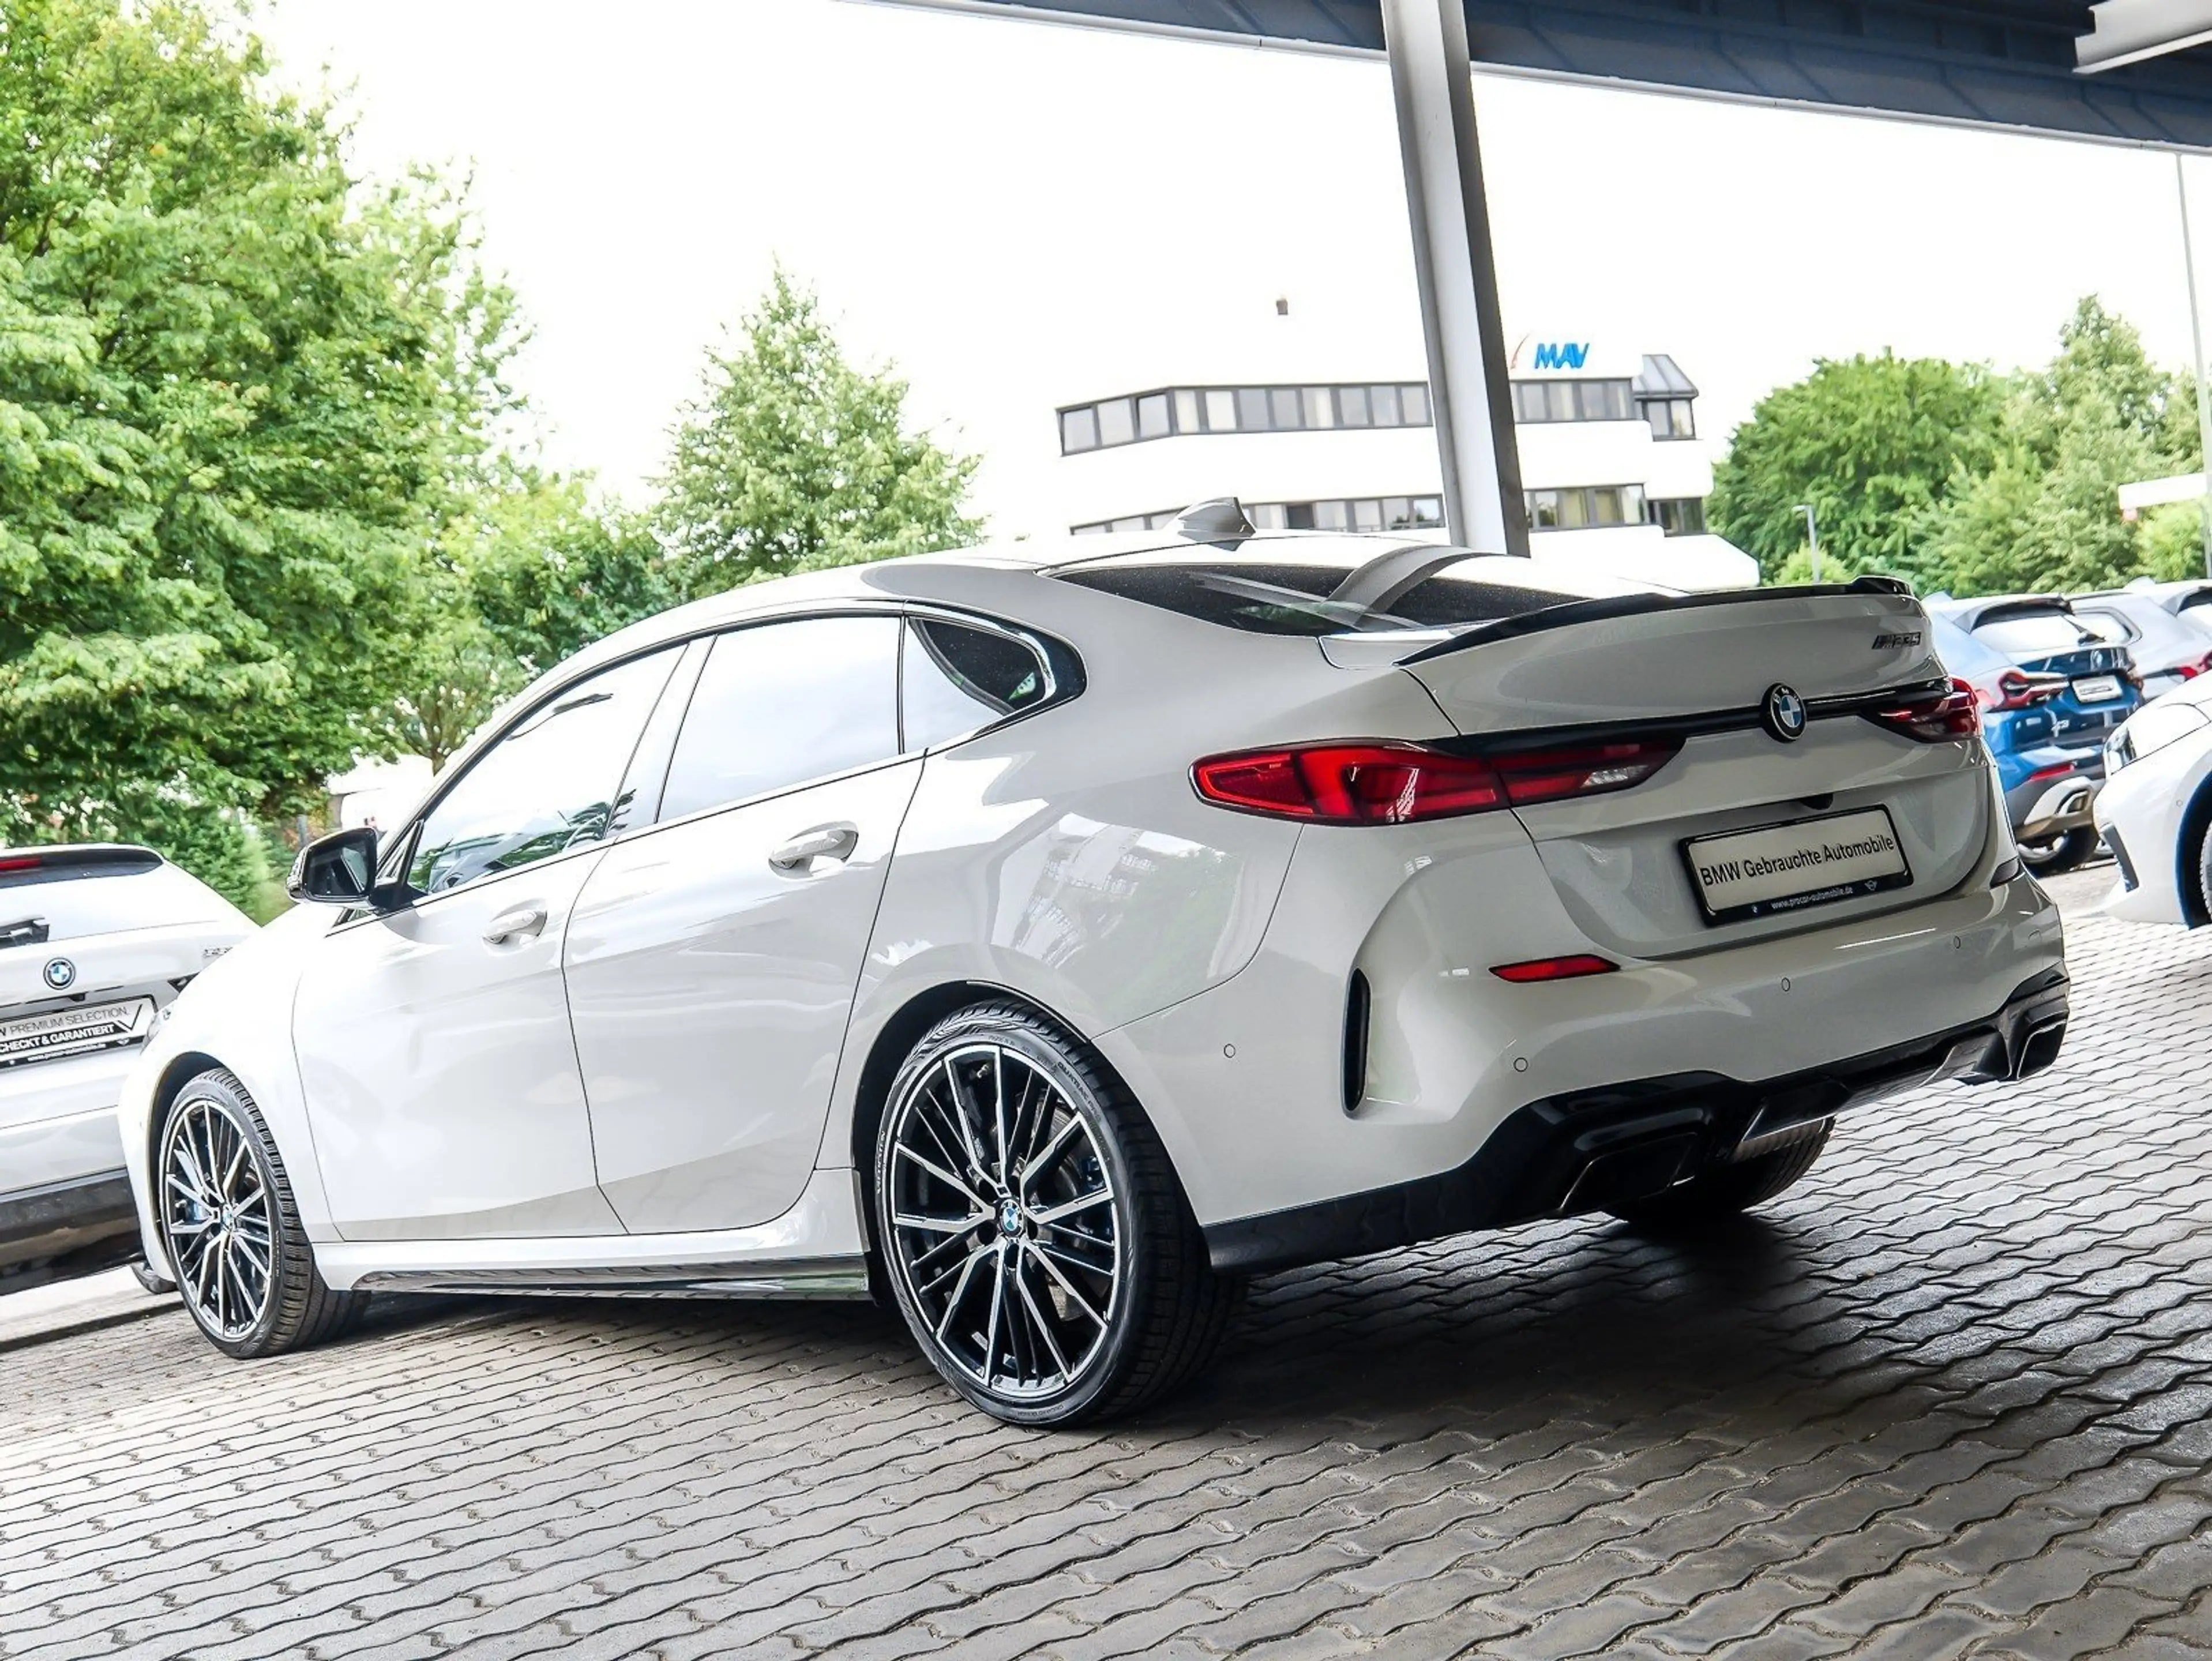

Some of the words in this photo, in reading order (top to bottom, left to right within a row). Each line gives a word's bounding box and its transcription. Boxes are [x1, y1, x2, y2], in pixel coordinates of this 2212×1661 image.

[1535, 343, 1590, 369] MAV
[1700, 860, 1740, 886] BMW
[1743, 850, 1822, 877] Gebrauchte
[1824, 835, 1894, 862] Automobile
[10, 1018, 63, 1034] PREMIUM
[42, 1035, 50, 1044] &
[50, 1024, 115, 1043] GARANTIERT
